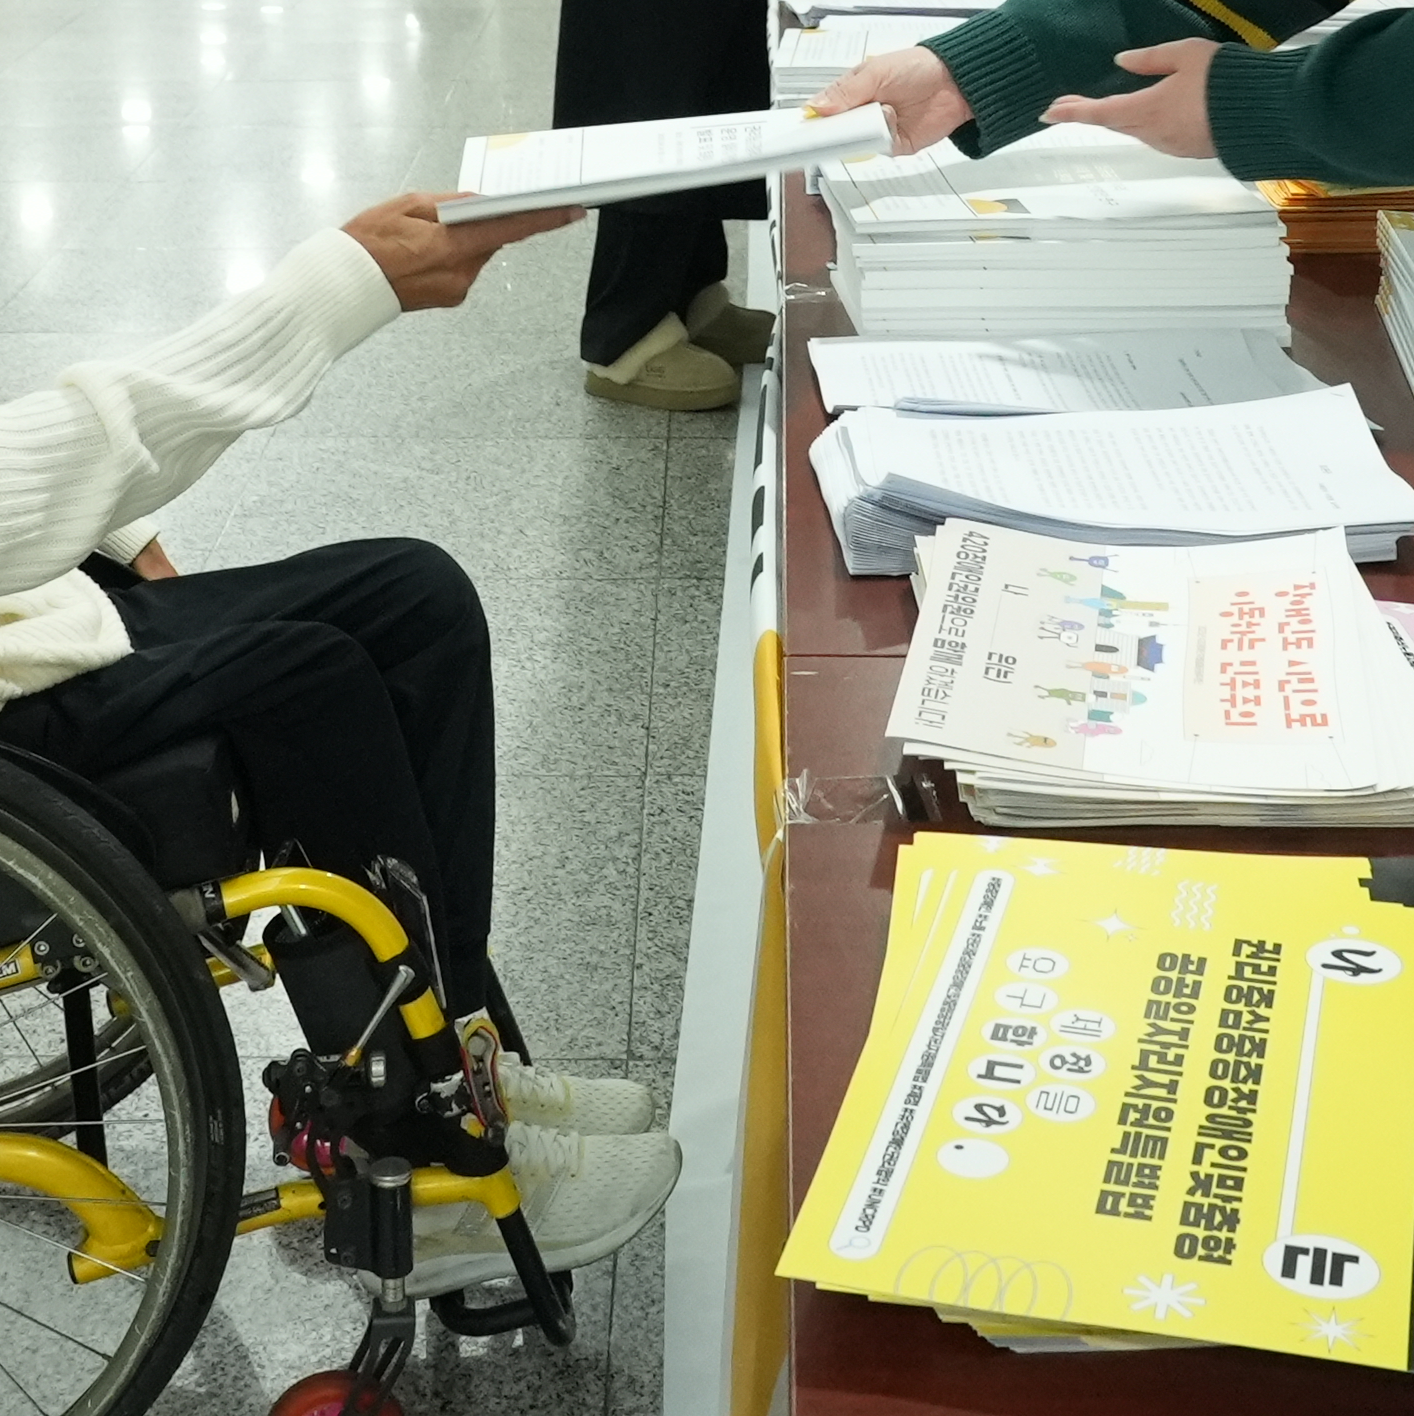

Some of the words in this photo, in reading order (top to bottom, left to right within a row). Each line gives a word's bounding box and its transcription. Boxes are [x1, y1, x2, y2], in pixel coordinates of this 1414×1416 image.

[1220, 590, 1266, 651] 이동하는
[1276, 583, 1315, 650] 장애인도
[1220, 660, 1262, 726] 민주주의
[1278, 659, 1329, 727] 시민으로
[1095, 951, 1207, 1221] 공공일자리지원특별법
[1174, 938, 1282, 1266] 권리중심중증장애인맞춤형
[1280, 1244, 1359, 1286] 는
